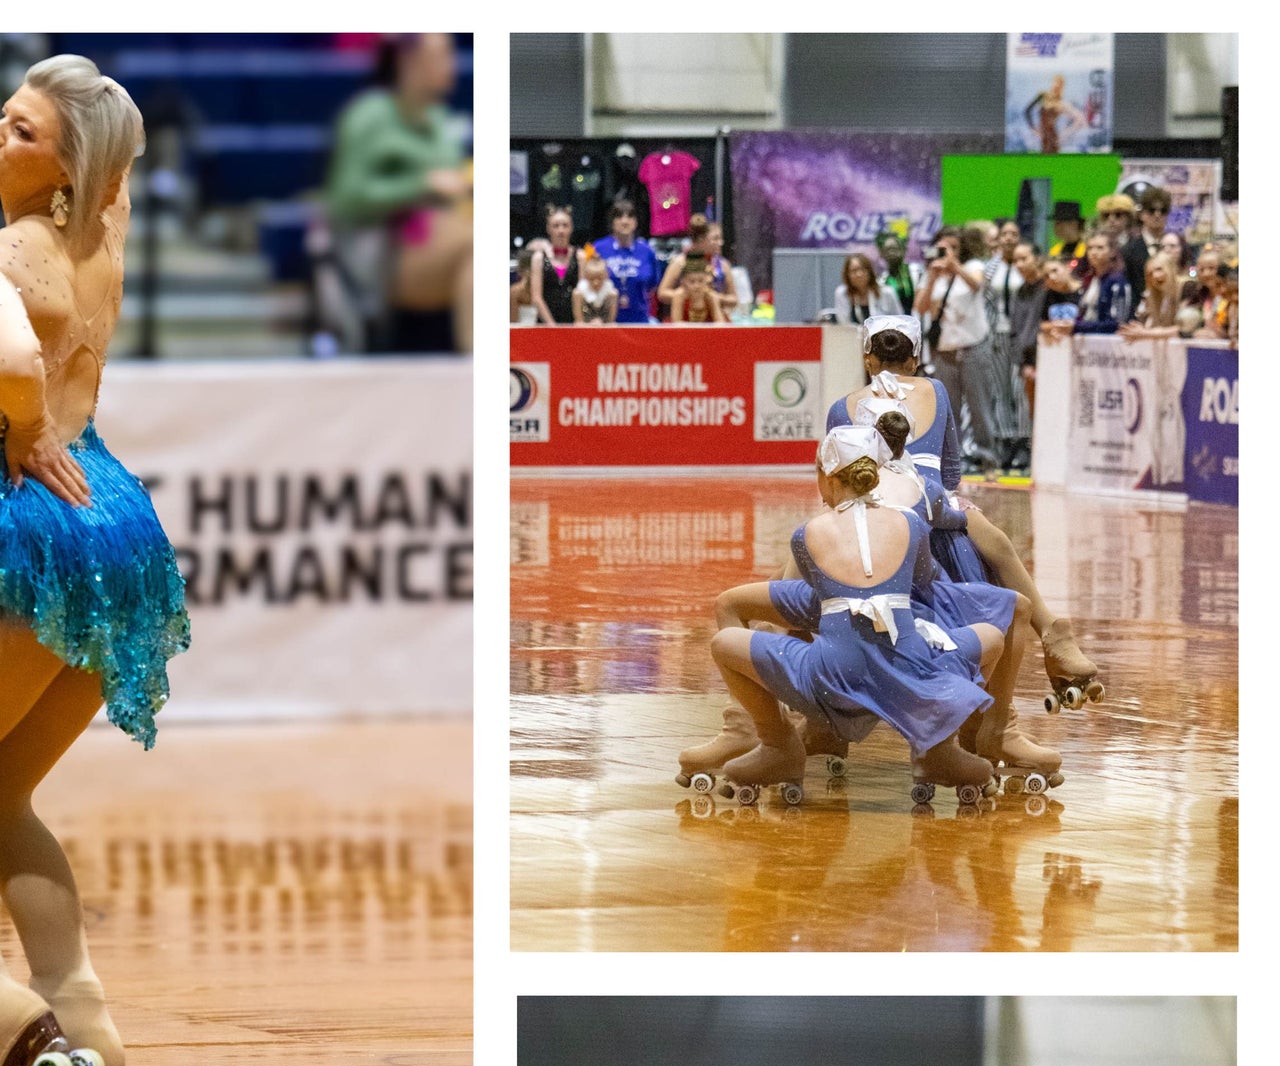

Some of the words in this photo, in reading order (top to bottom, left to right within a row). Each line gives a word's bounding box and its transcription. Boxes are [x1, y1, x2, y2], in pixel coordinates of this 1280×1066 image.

[597, 363, 707, 393] NATIONAL
[558, 396, 746, 427] CHAMPIONSHIPS
[510, 418, 539, 431] SA
[761, 424, 814, 438] SKATE
